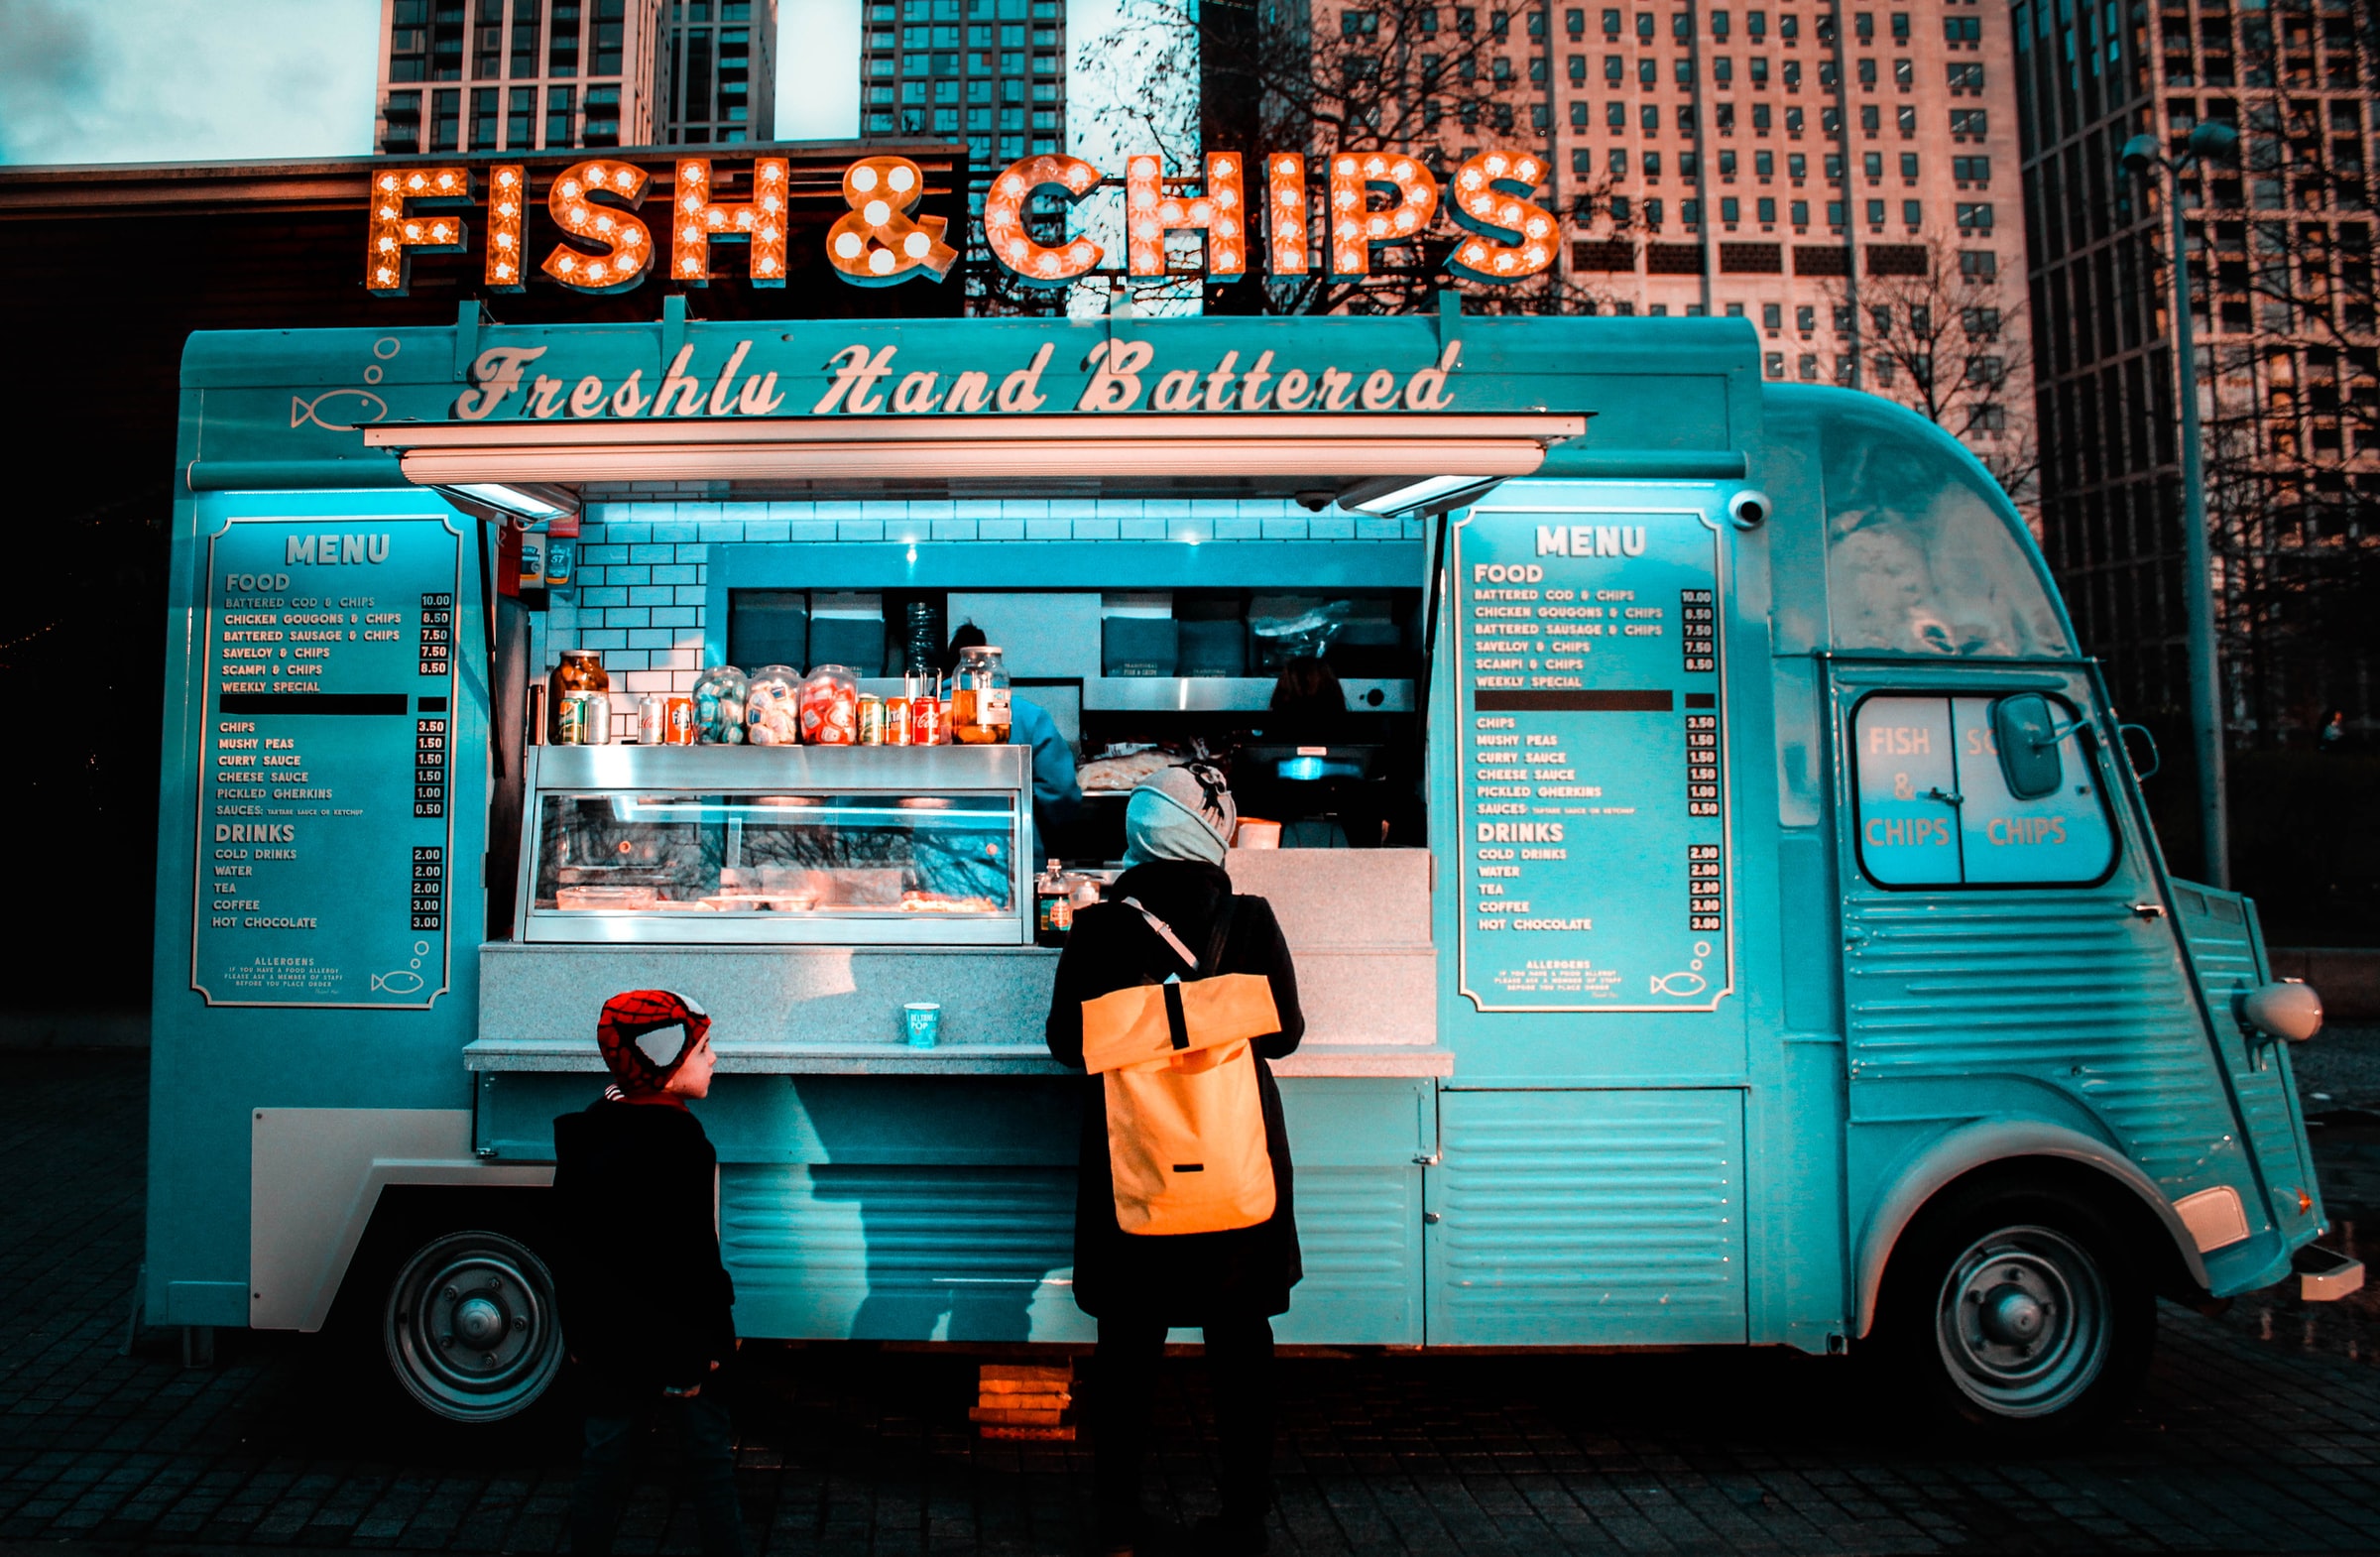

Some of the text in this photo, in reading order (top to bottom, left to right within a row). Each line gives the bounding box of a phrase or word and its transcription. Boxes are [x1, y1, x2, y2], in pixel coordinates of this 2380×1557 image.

[366, 150, 1562, 295] FISH & CHIPS
[813, 342, 1048, 416] Hand
[1080, 337, 1463, 412] Battered
[1537, 525, 1645, 555] MENU
[288, 534, 390, 562] MENU
[1476, 564, 1543, 582] FOOD
[227, 573, 290, 590] FOOD
[1475, 589, 1711, 602] BATTERED COD & CHIPS 10.00
[226, 598, 284, 607] BATTERED
[293, 598, 317, 607] COD
[340, 597, 374, 606] CHIPS
[422, 596, 449, 605] 10.00
[225, 613, 448, 624] CHICKEN GOUGONS & CHIPS 8.50
[1476, 607, 1712, 619] CHICKEN GOUGONS & CHIPS 8.50
[224, 630, 446, 641] BATTERED SAUSAGE & CHIPS 7.50
[1476, 624, 1712, 636] BATTERED SAUSAGE & CHIPS 7.50
[223, 647, 446, 658] SAVELOY & CHIPS 7.50
[1476, 642, 1712, 653] SAVELOY & CHIPS 7.50
[223, 662, 445, 674] SCAMPI & CHIPS 8.50
[1476, 659, 1713, 669] SCAMPI & CHIPS 8.50
[222, 682, 319, 691] WEEKLY SPECIAL
[1477, 676, 1582, 686] WEEKLY SPECIAL
[220, 721, 443, 732] CHIPS 3.50
[1477, 717, 1715, 728] CHIPS 3.50
[219, 738, 441, 748] MUSHY PEAS 1.50
[1477, 735, 1714, 746] MUSHY PEAS 1.50
[1868, 727, 1931, 755] FISH
[219, 754, 441, 765] CURRY SAUCE 1.50
[1478, 752, 1715, 763] CURRY SAUCE 1.50
[218, 771, 440, 781] CHEESE SAUCE 1.50
[1478, 769, 1716, 779] CHEESE SAUCE 1.50
[1478, 785, 1716, 797] PICKLED GHERKINS 1.00
[1894, 773, 1916, 800] &
[274, 789, 332, 798] GHERKINS
[417, 787, 440, 797] 1.00
[416, 804, 440, 814] 0.50
[1691, 803, 1718, 814] 0.50
[216, 824, 294, 841] DRINKS
[1479, 823, 1563, 842] DRINKS
[1865, 818, 1951, 847] CHIPS
[1986, 817, 2068, 846] CHIPS
[216, 849, 439, 860] COLD DRINKS 2.00
[1479, 847, 1718, 859] COLD DRINKS 2.00
[215, 866, 439, 876] WATER 2.00
[1479, 865, 1719, 877] WATER 2.00
[214, 884, 438, 893] TEA 2.00
[1480, 882, 1720, 895] TEA 2.00
[214, 900, 437, 910] COFFEE 3.00
[1480, 899, 1720, 912] COFFEE 3.00
[213, 917, 437, 927] HOT CHOCOLATE 3.00
[1480, 917, 1719, 929] HOT CHOCOLATE 3.00
